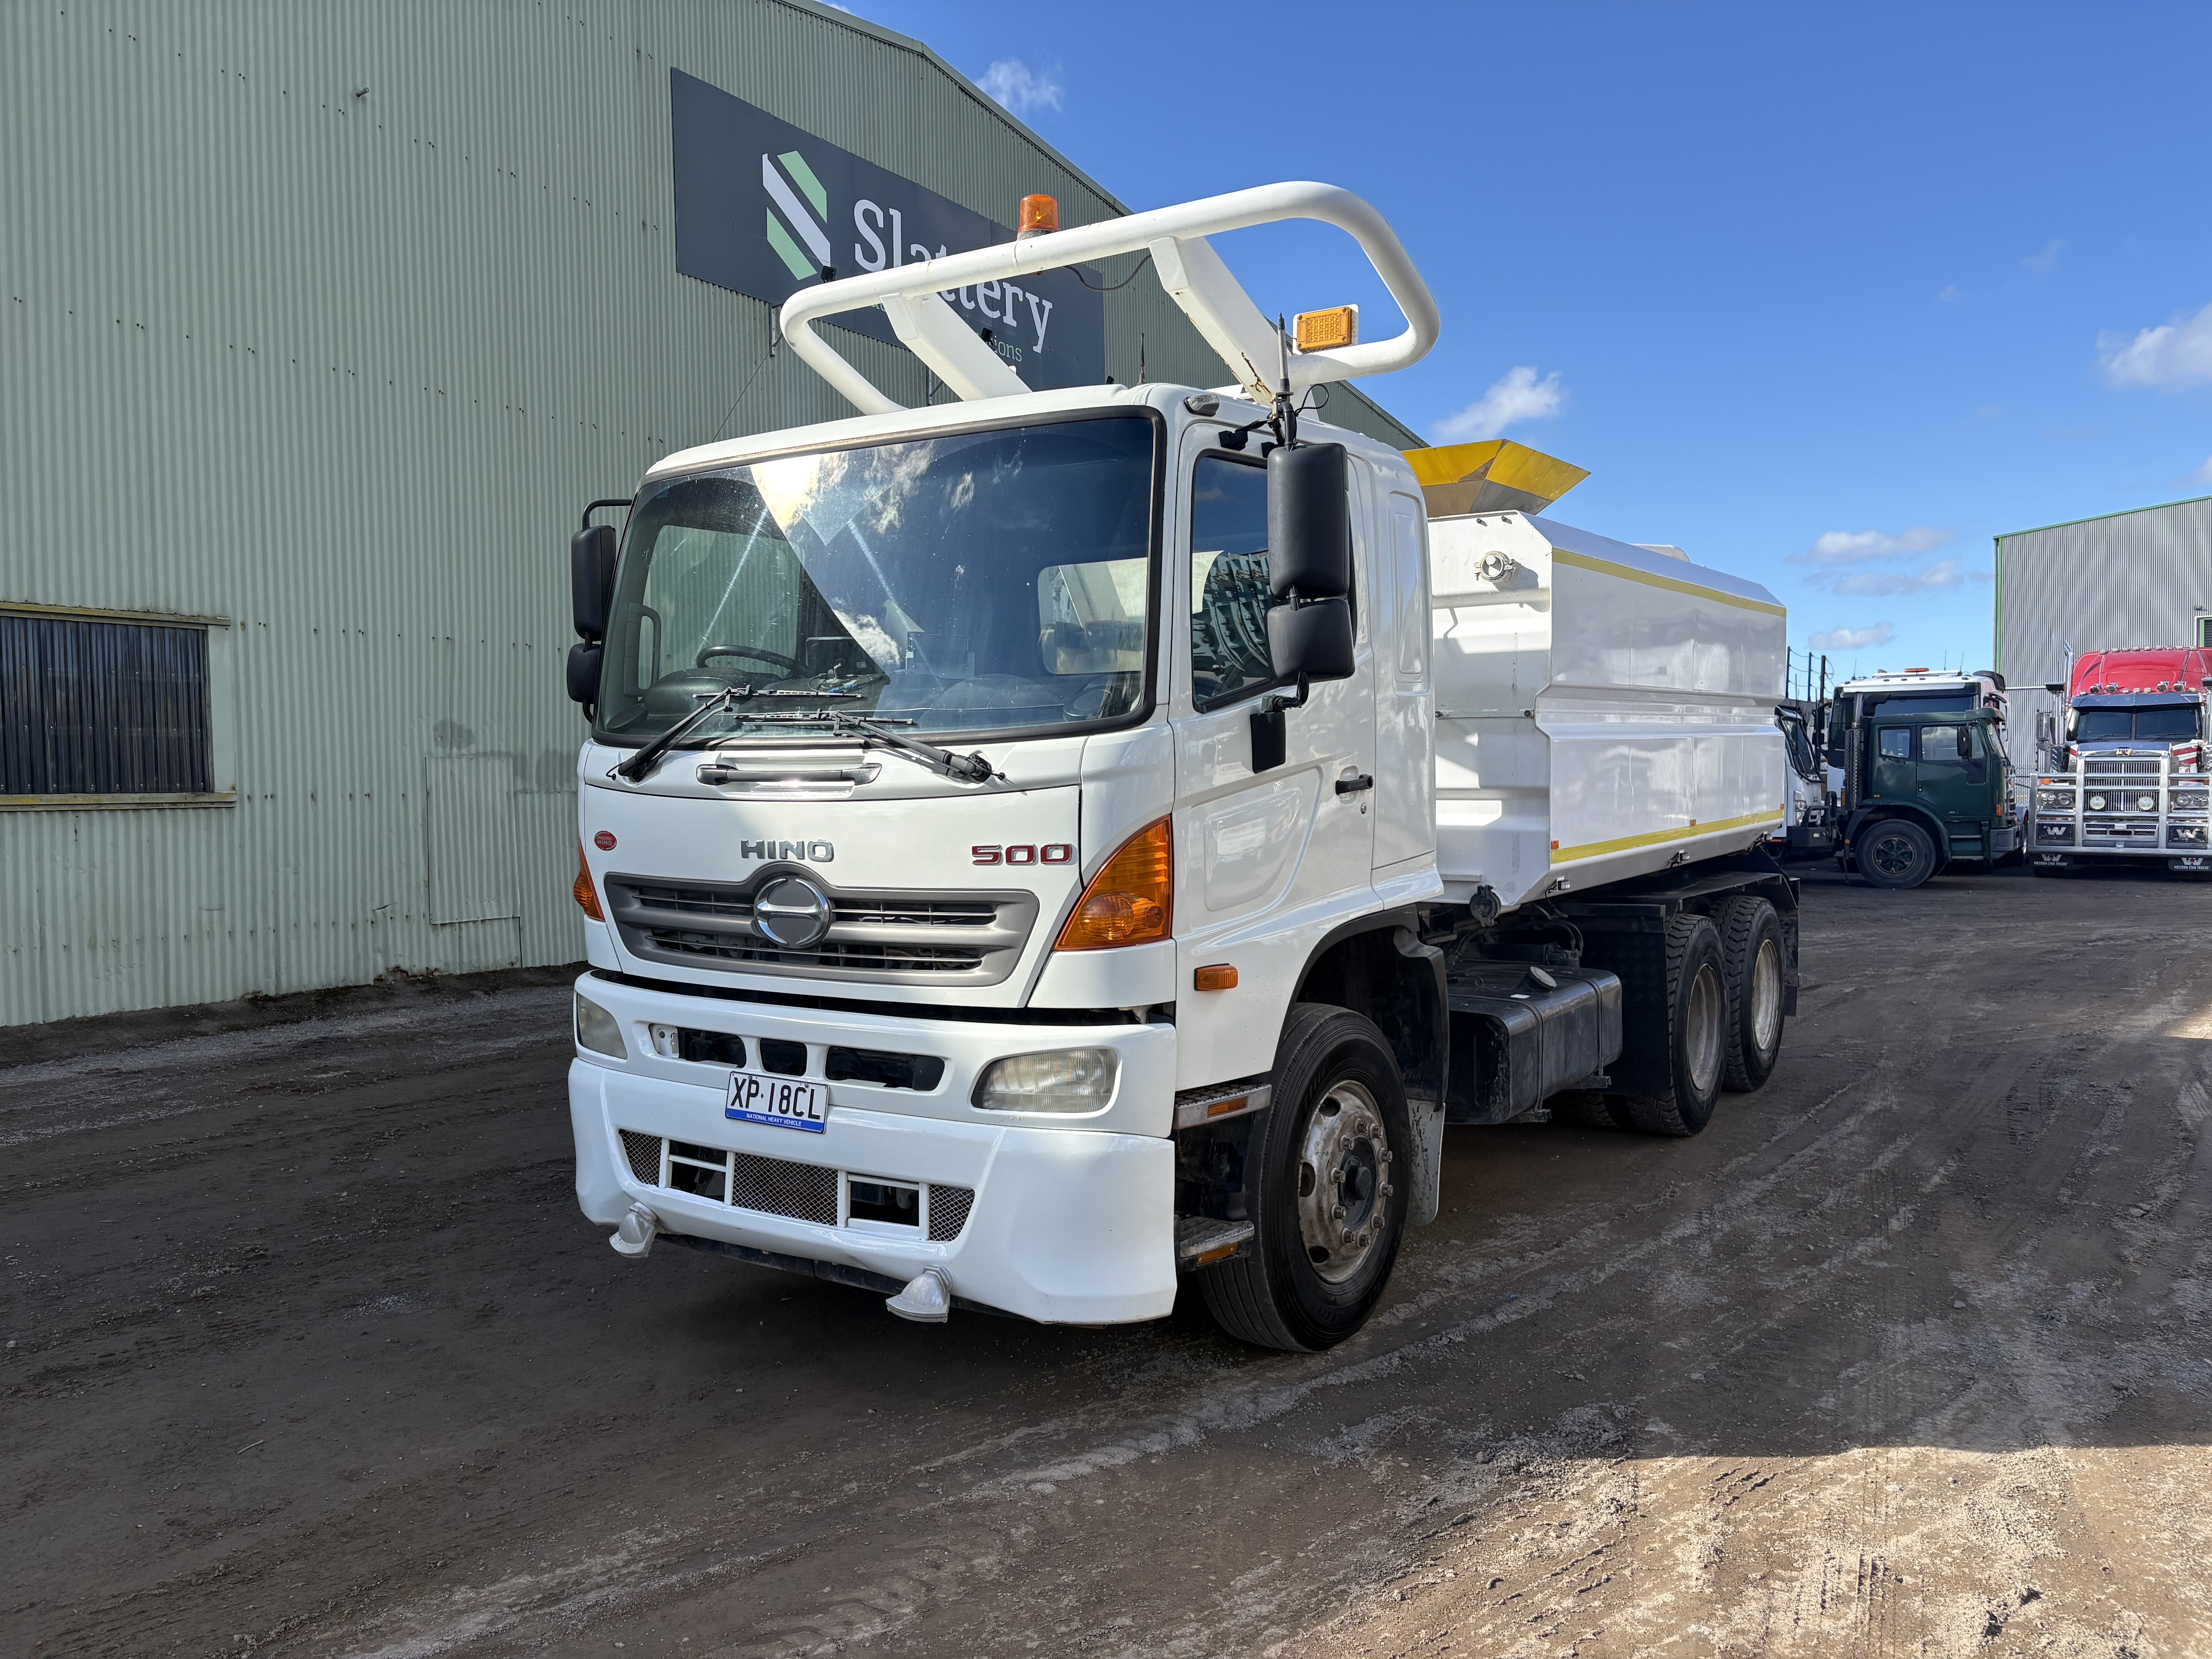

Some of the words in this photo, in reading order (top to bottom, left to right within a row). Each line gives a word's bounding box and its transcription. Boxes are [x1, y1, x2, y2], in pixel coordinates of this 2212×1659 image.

[740, 840, 834, 862] HINO
[972, 843, 1075, 866] 500
[746, 1113, 767, 1121] NATIONAL
